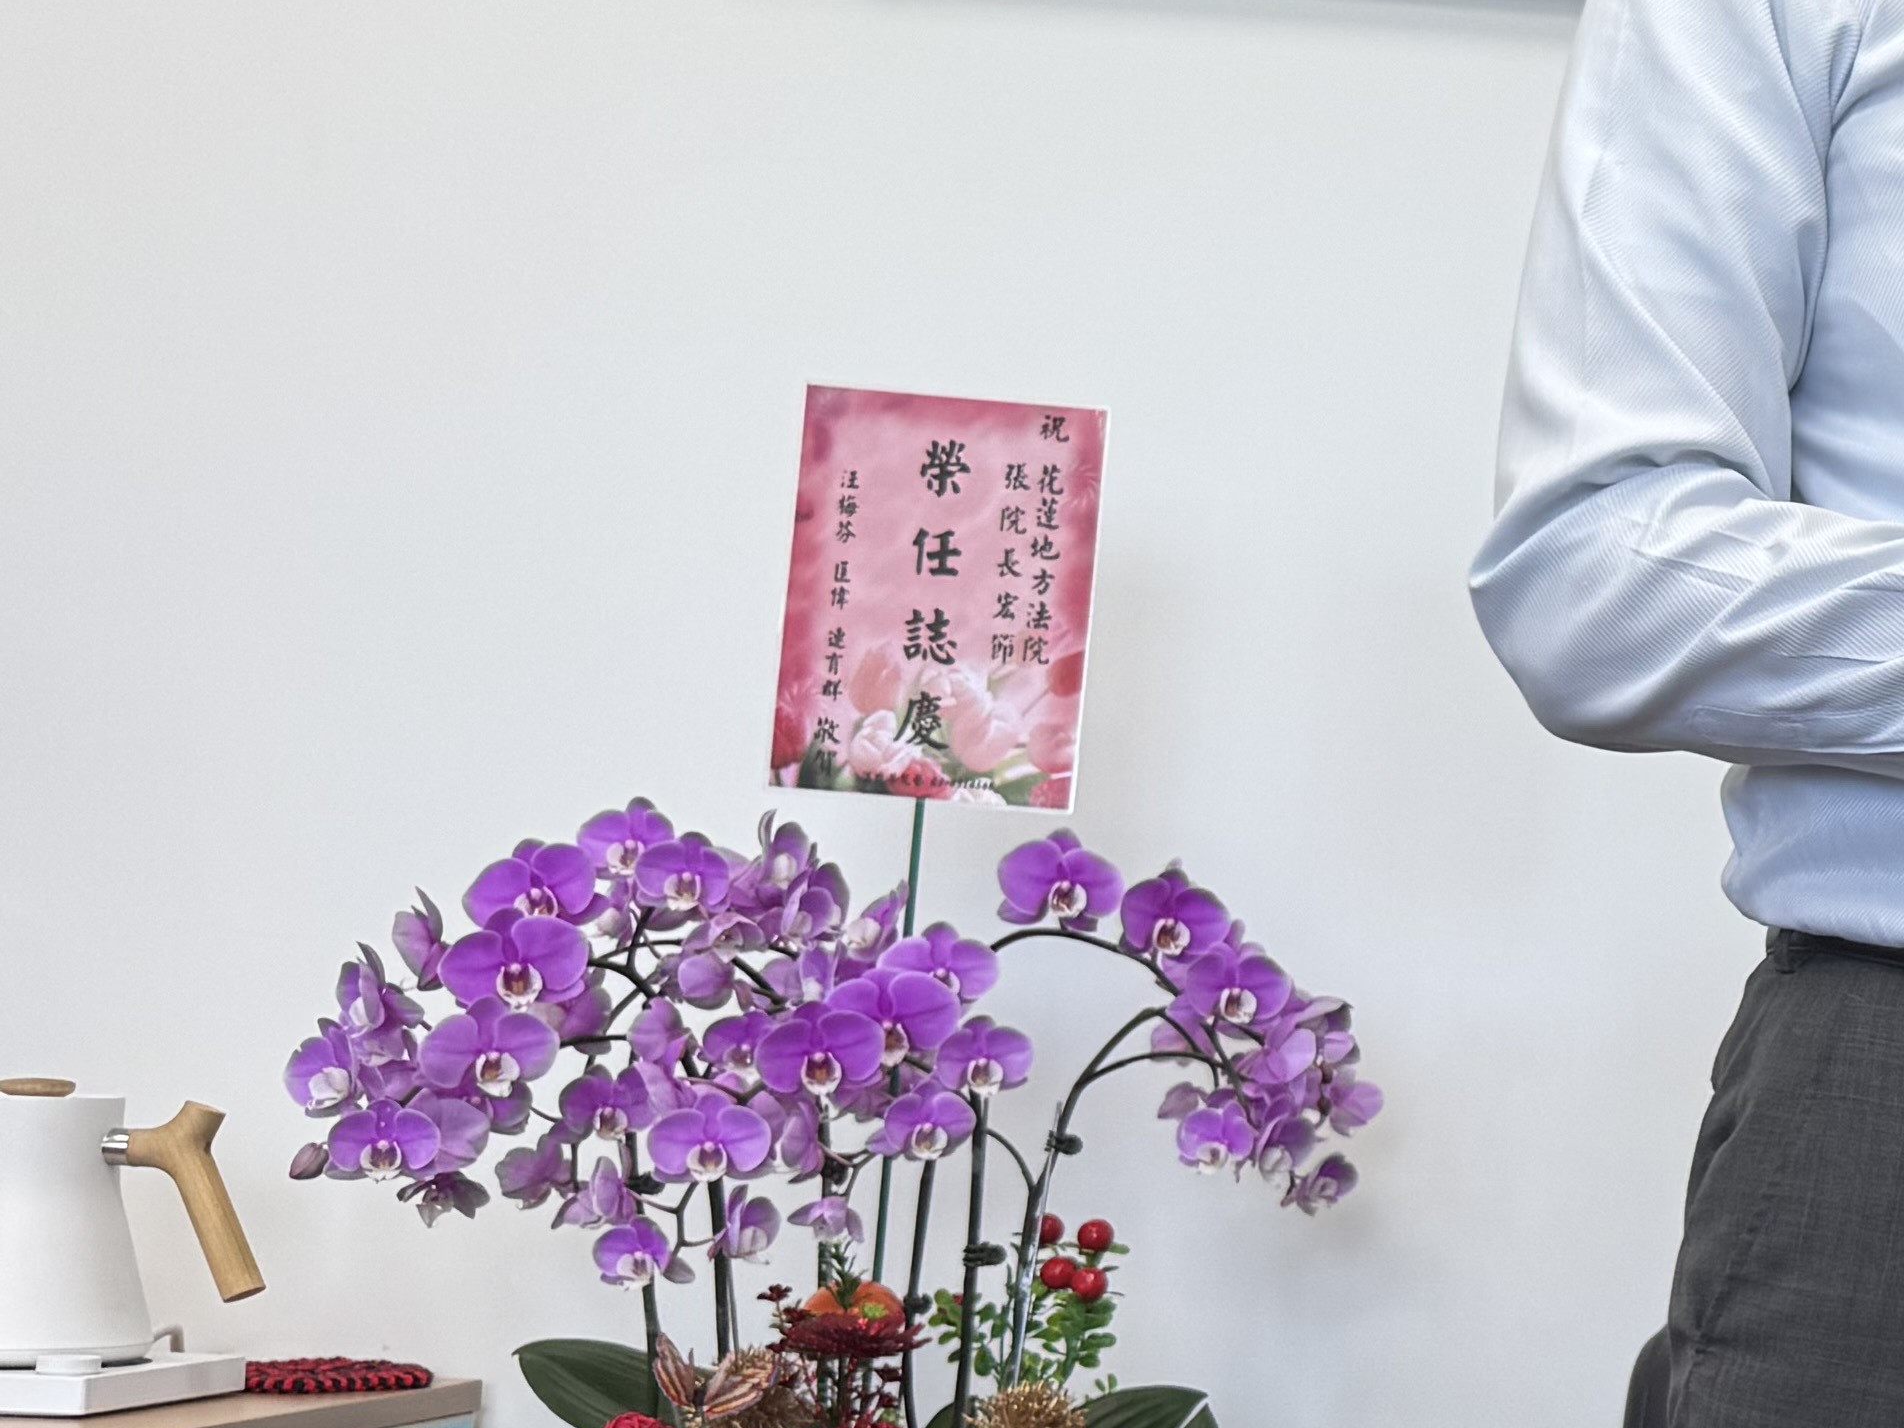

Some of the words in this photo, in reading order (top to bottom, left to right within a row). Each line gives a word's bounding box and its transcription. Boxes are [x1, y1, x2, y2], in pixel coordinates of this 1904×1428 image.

[893, 439, 972, 750] 榮任誌慶
[991, 462, 1031, 665] 張院長宏節
